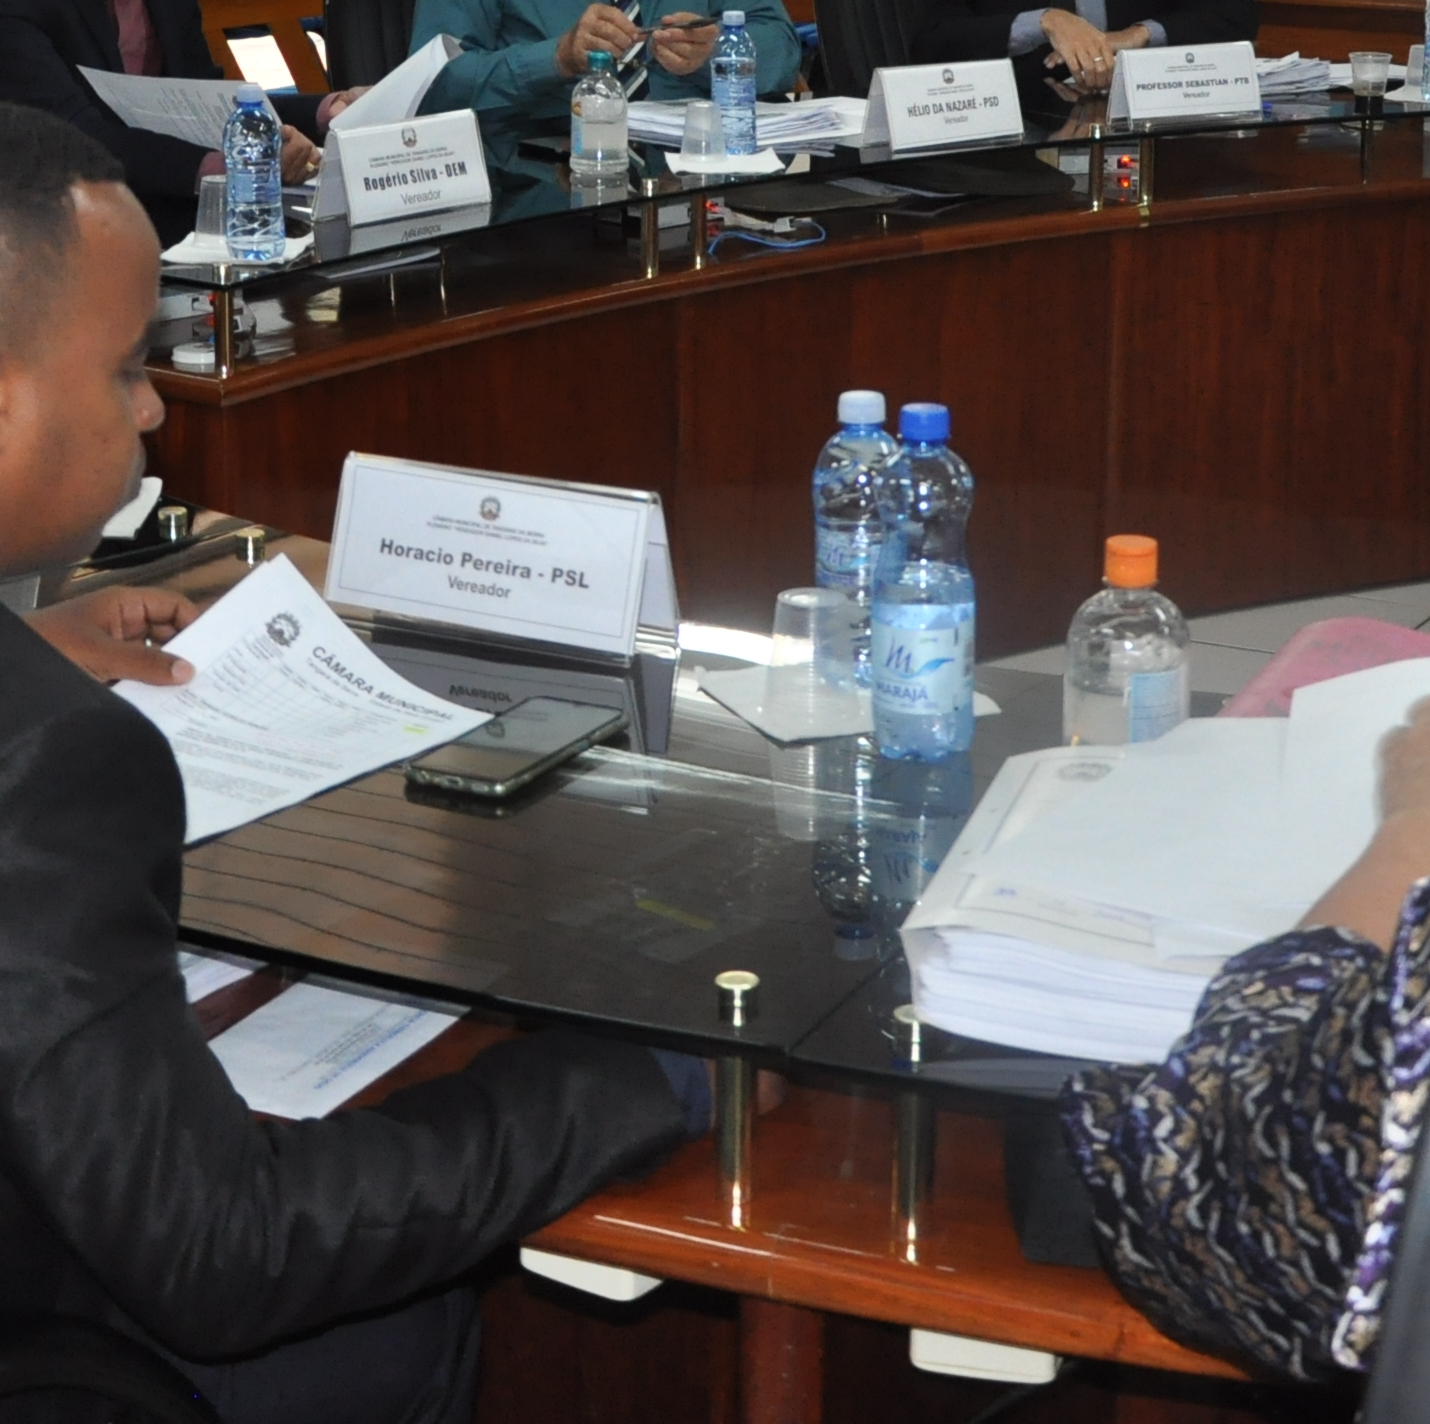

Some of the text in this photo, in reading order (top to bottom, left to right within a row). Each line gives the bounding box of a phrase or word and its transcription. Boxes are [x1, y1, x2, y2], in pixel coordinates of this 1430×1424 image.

[1136, 80, 1183, 91] PROFESSOR
[1185, 78, 1229, 88] SEBASTIAN
[1234, 77, 1250, 86] PTB
[907, 103, 931, 117] HÉLIO
[932, 104, 944, 115] DA
[945, 95, 978, 113] NAZARÉ
[983, 95, 1000, 108] PSD
[363, 171, 409, 192] Rogério
[409, 167, 438, 184] Silva
[444, 161, 468, 178] DEM
[400, 189, 442, 205] Vereador
[379, 537, 454, 566] Horacio
[459, 551, 532, 580] Pereira
[550, 566, 590, 589] PSL
[447, 575, 512, 599] Vereador
[312, 645, 374, 695] CÂMARA
[375, 690, 454, 721] MUNICIPAL
